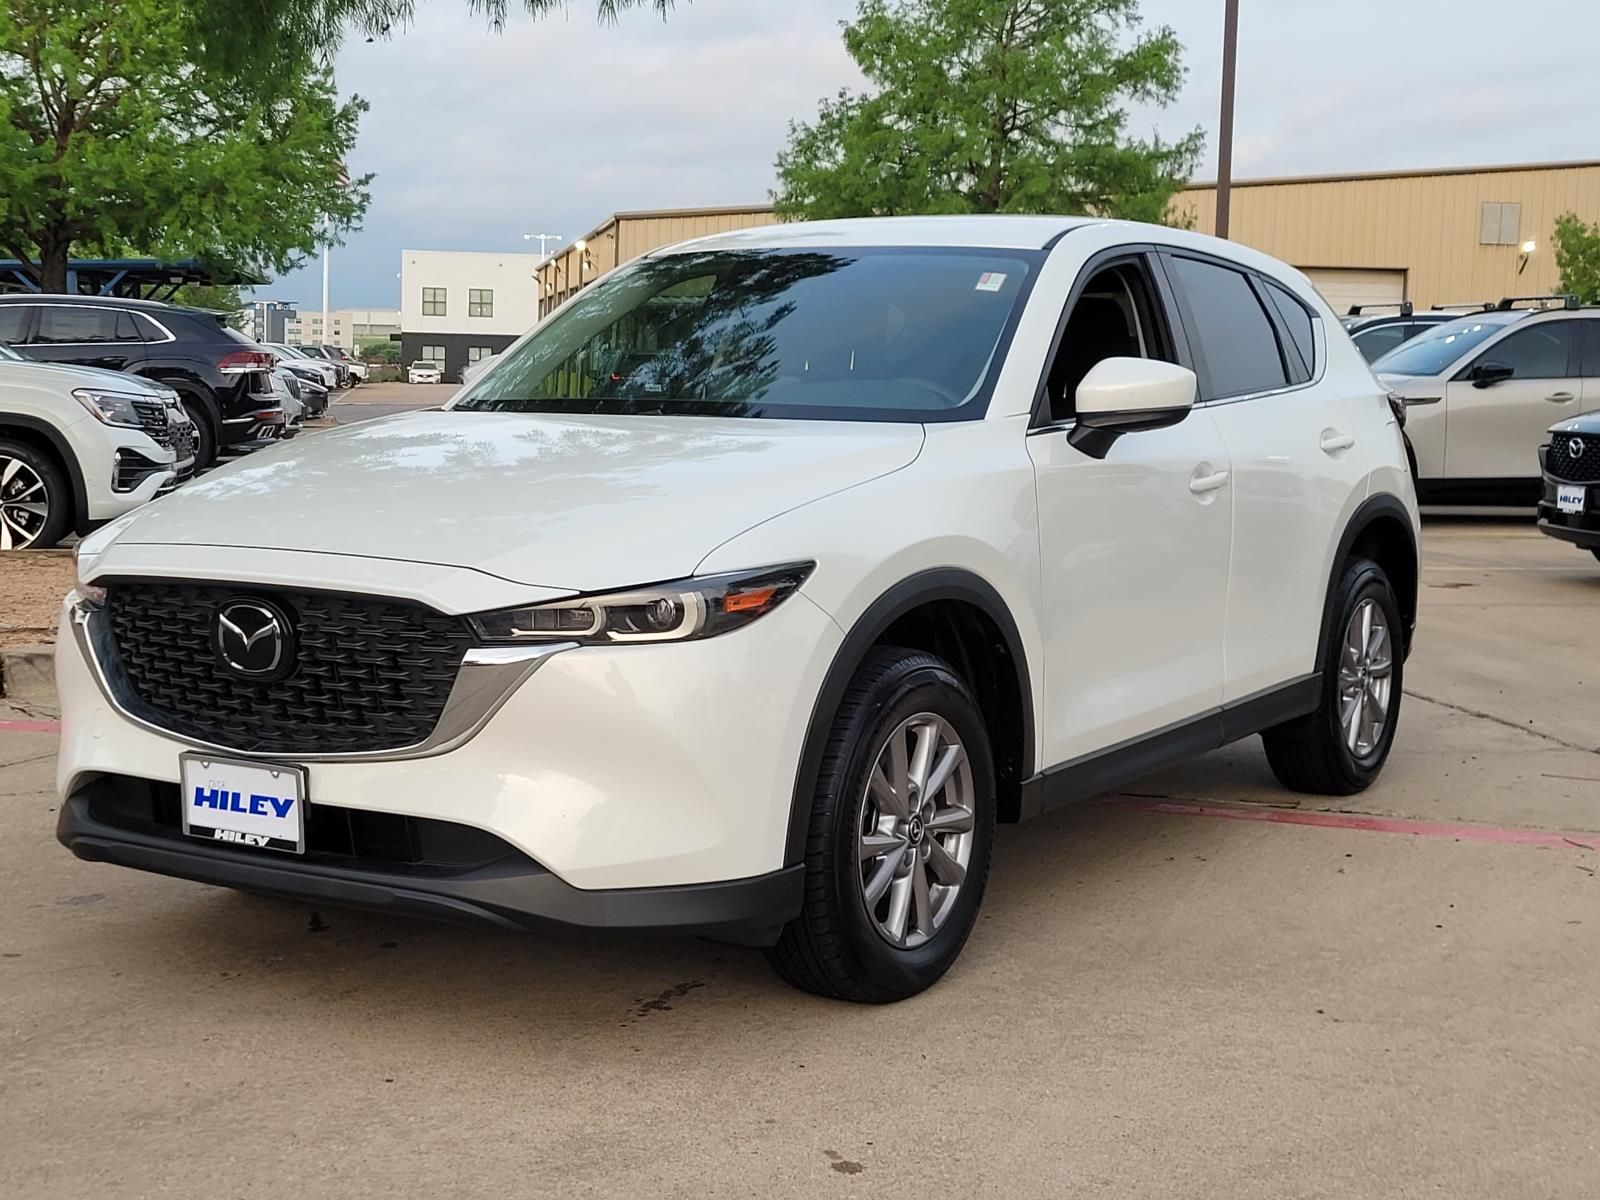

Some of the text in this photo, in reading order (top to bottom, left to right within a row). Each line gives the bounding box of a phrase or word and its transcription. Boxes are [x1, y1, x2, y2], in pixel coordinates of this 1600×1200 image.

[1560, 495, 1582, 504] HILEY
[194, 787, 294, 818] HILEY
[214, 829, 270, 847] HILEY
